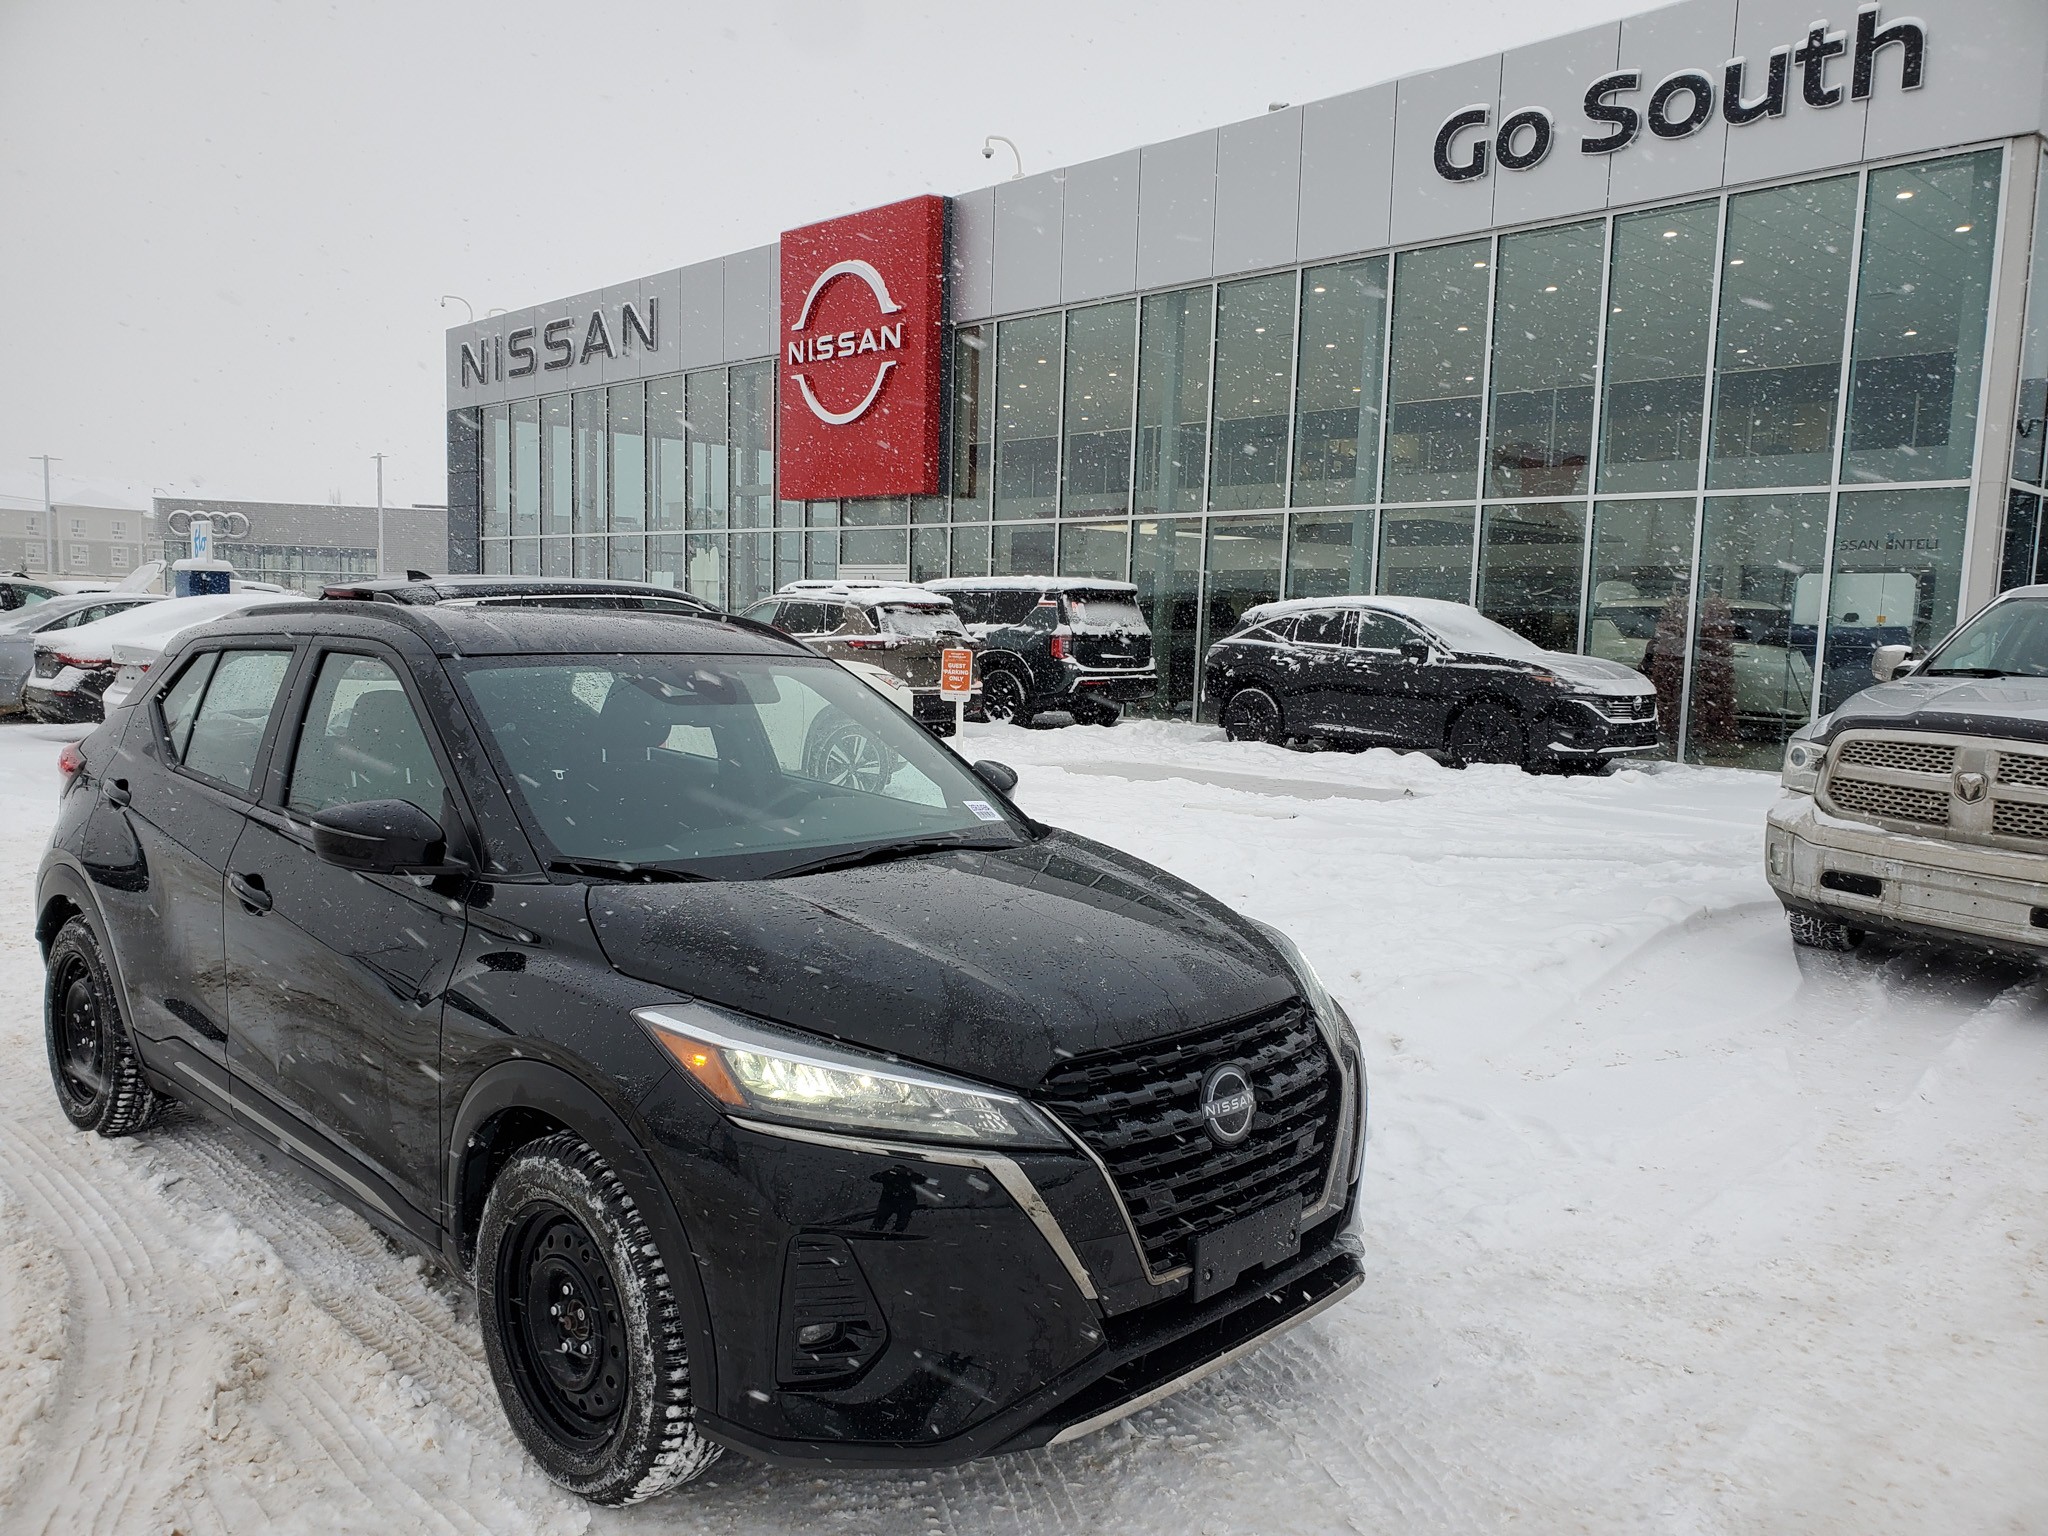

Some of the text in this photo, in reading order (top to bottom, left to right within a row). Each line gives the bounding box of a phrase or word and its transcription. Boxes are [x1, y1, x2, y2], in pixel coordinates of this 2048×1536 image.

[1433, 2, 1928, 183] Go South
[461, 296, 659, 388] NISSAN
[788, 323, 901, 366] NISSAN
[1205, 1091, 1254, 1117] NISSAN
